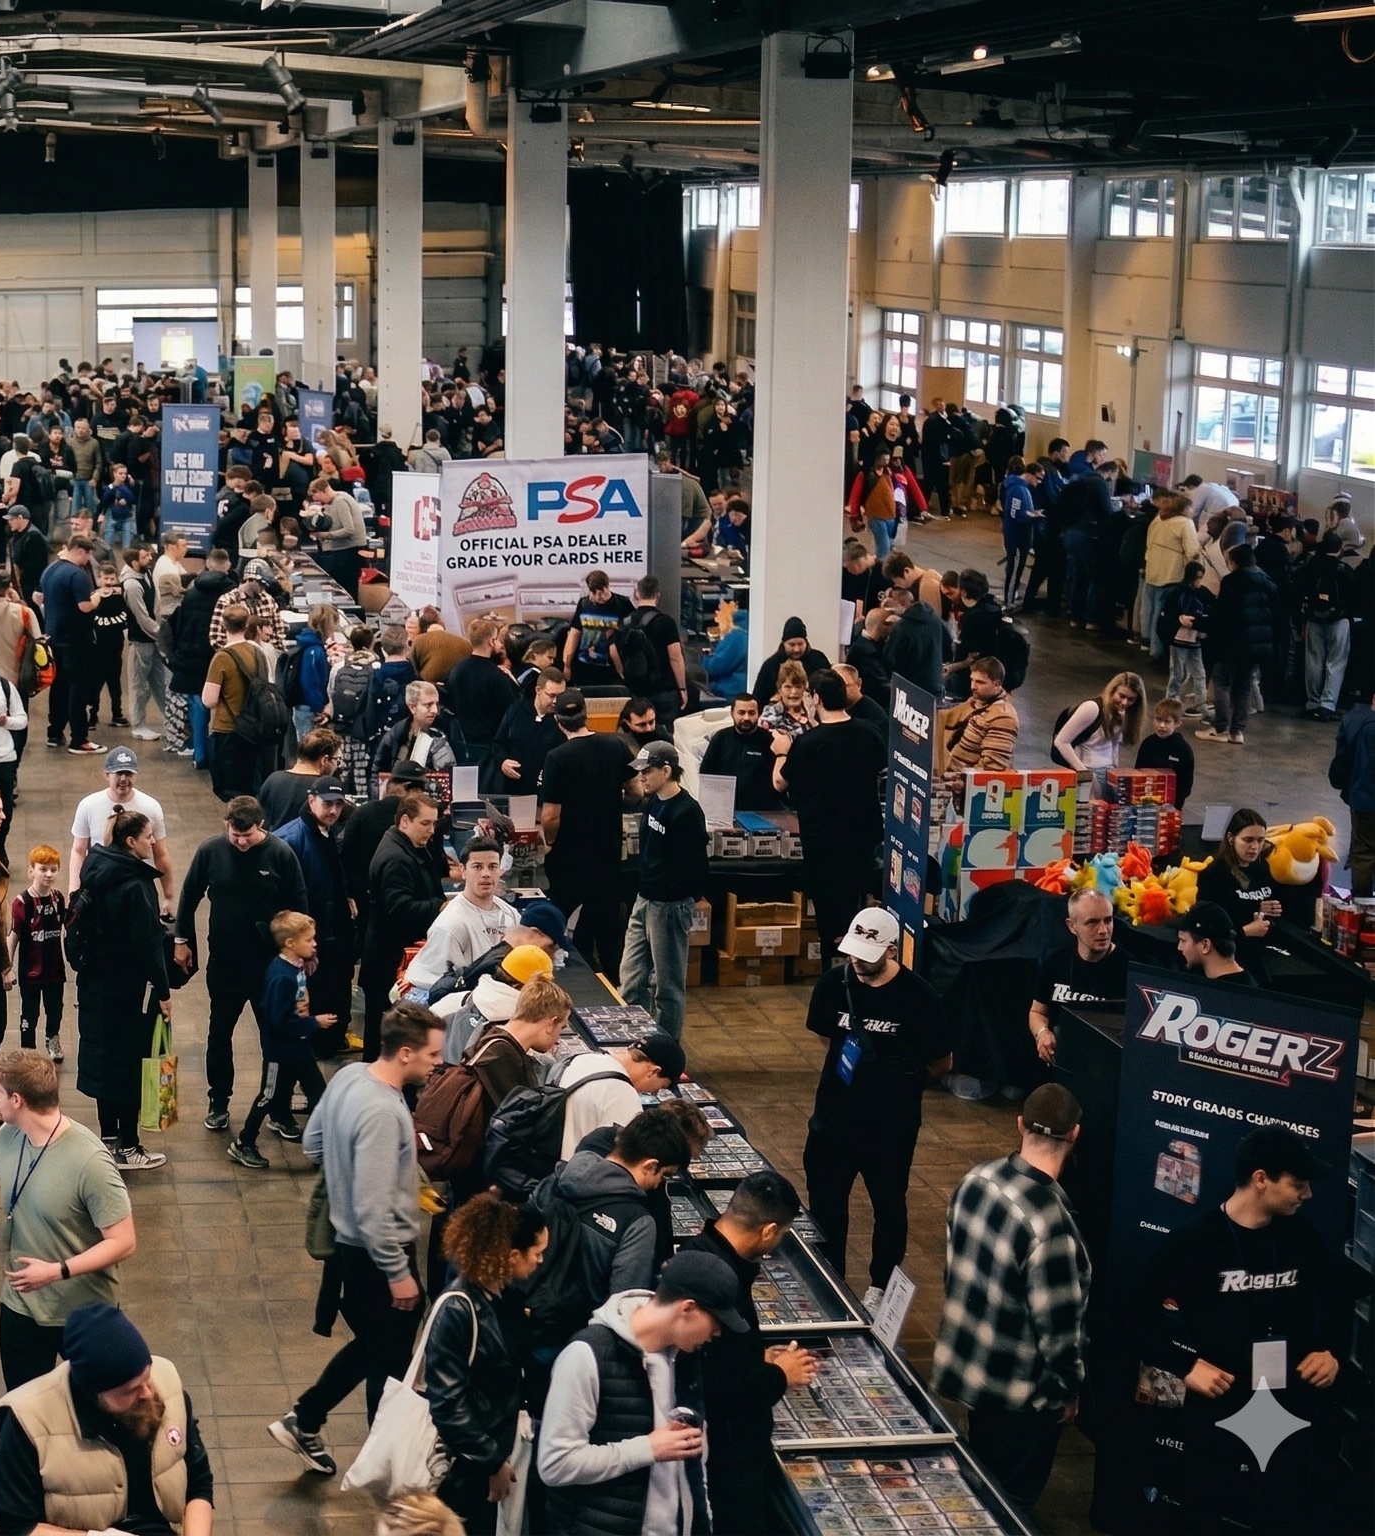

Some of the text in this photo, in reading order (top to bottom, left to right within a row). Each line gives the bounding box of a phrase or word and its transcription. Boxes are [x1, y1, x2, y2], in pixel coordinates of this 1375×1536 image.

[527, 475, 643, 524] PSA
[460, 534, 627, 551] OFFICIAL PSA DEALER
[446, 550, 643, 569] GRADE YOUR CARDS HERE
[1140, 991, 1345, 1079] ROGERZ
[1152, 1090, 1191, 1108] STORY
